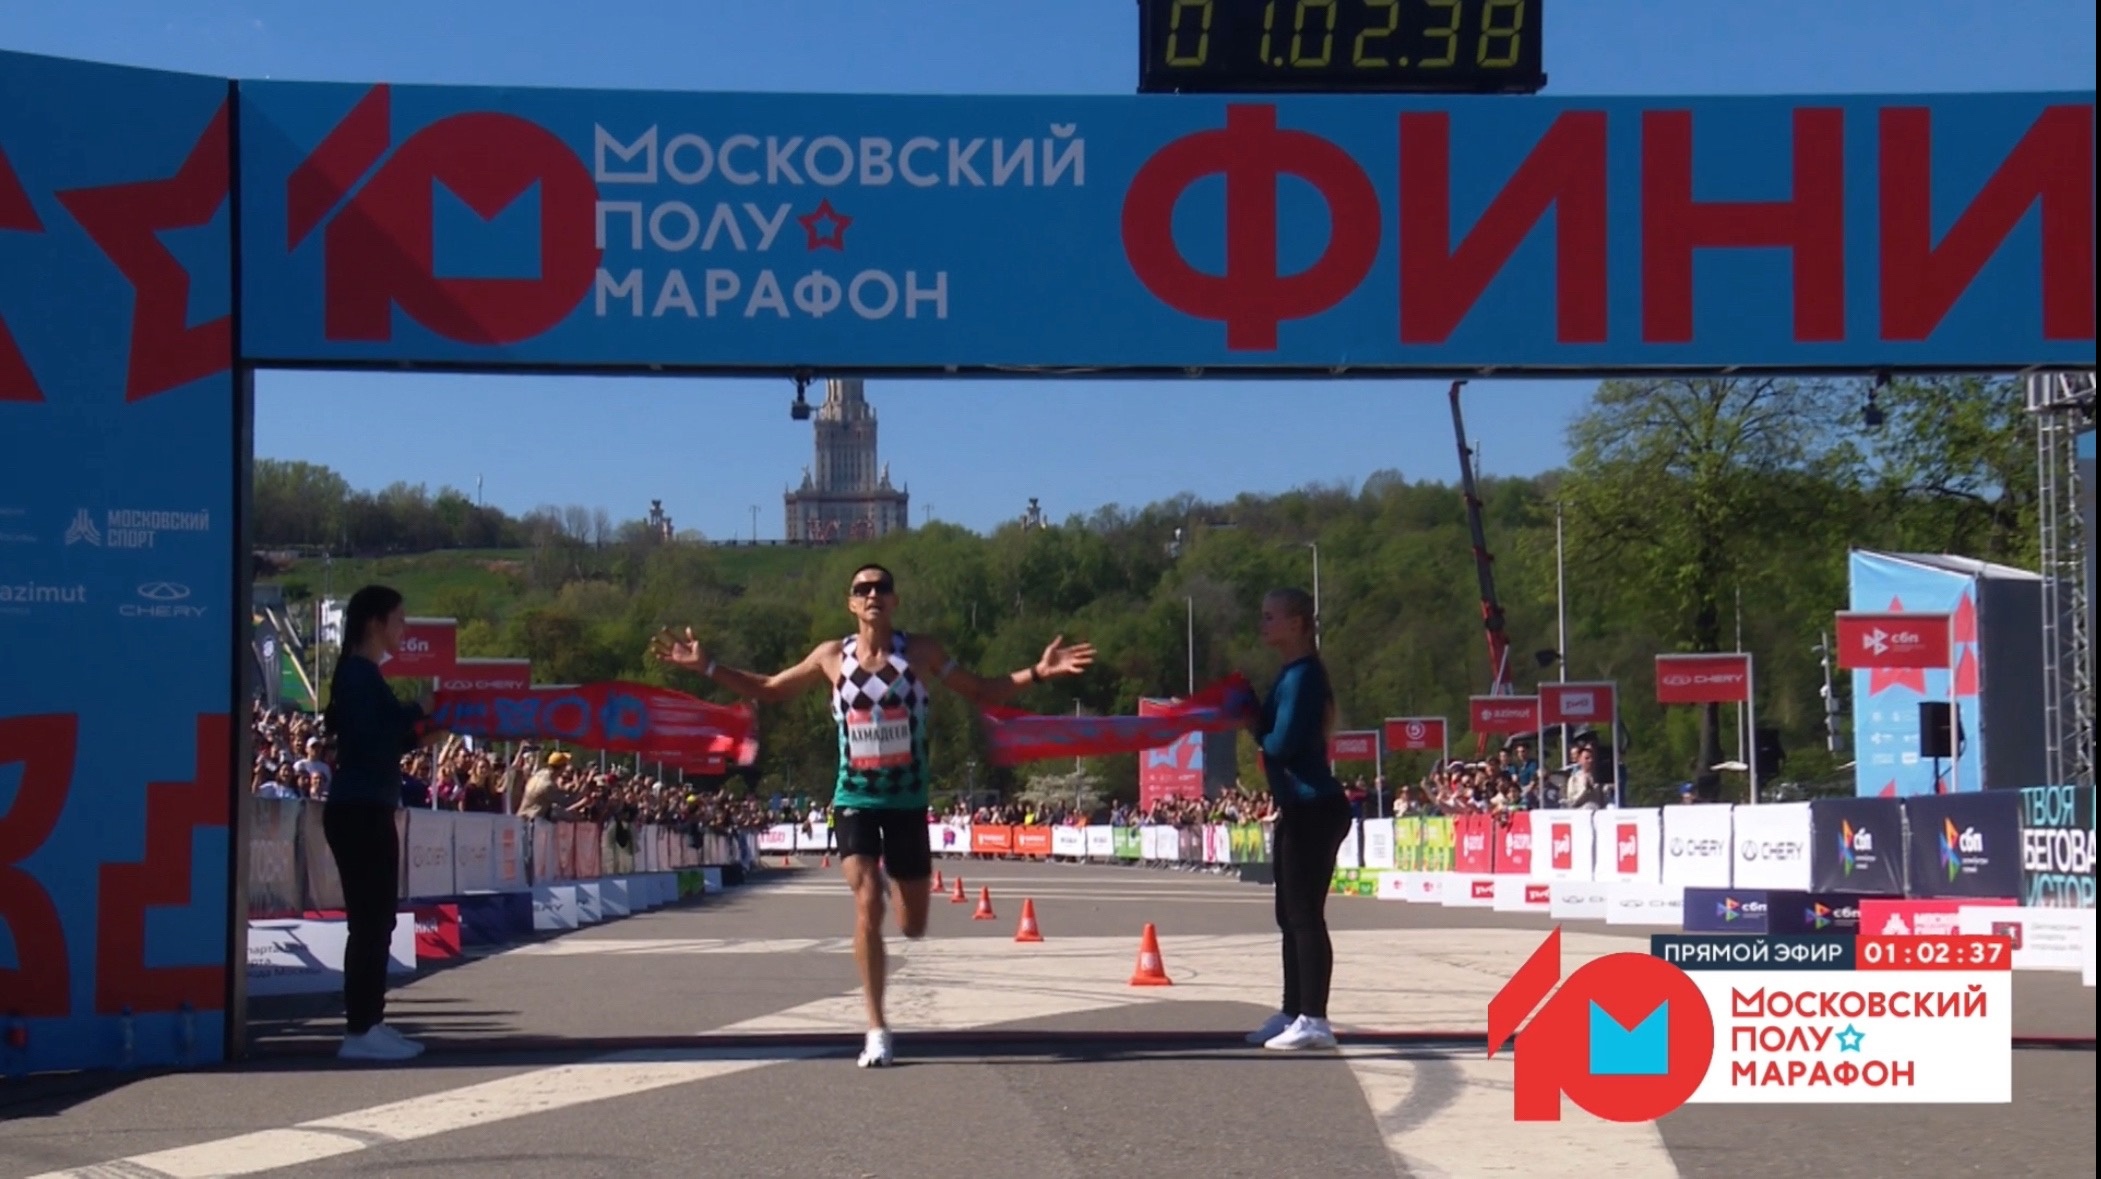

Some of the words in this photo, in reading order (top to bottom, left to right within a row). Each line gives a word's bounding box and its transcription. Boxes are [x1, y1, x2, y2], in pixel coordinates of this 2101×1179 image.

[595, 201, 792, 251] ПОЛУ
[595, 268, 948, 319] МАРАФОН
[107, 508, 209, 531] МОСКОВСКИЙ
[107, 530, 155, 548] СПОРТ
[0, 581, 86, 602] azimut
[119, 604, 208, 617] CHERY
[2020, 784, 2075, 826] ТВОЯ
